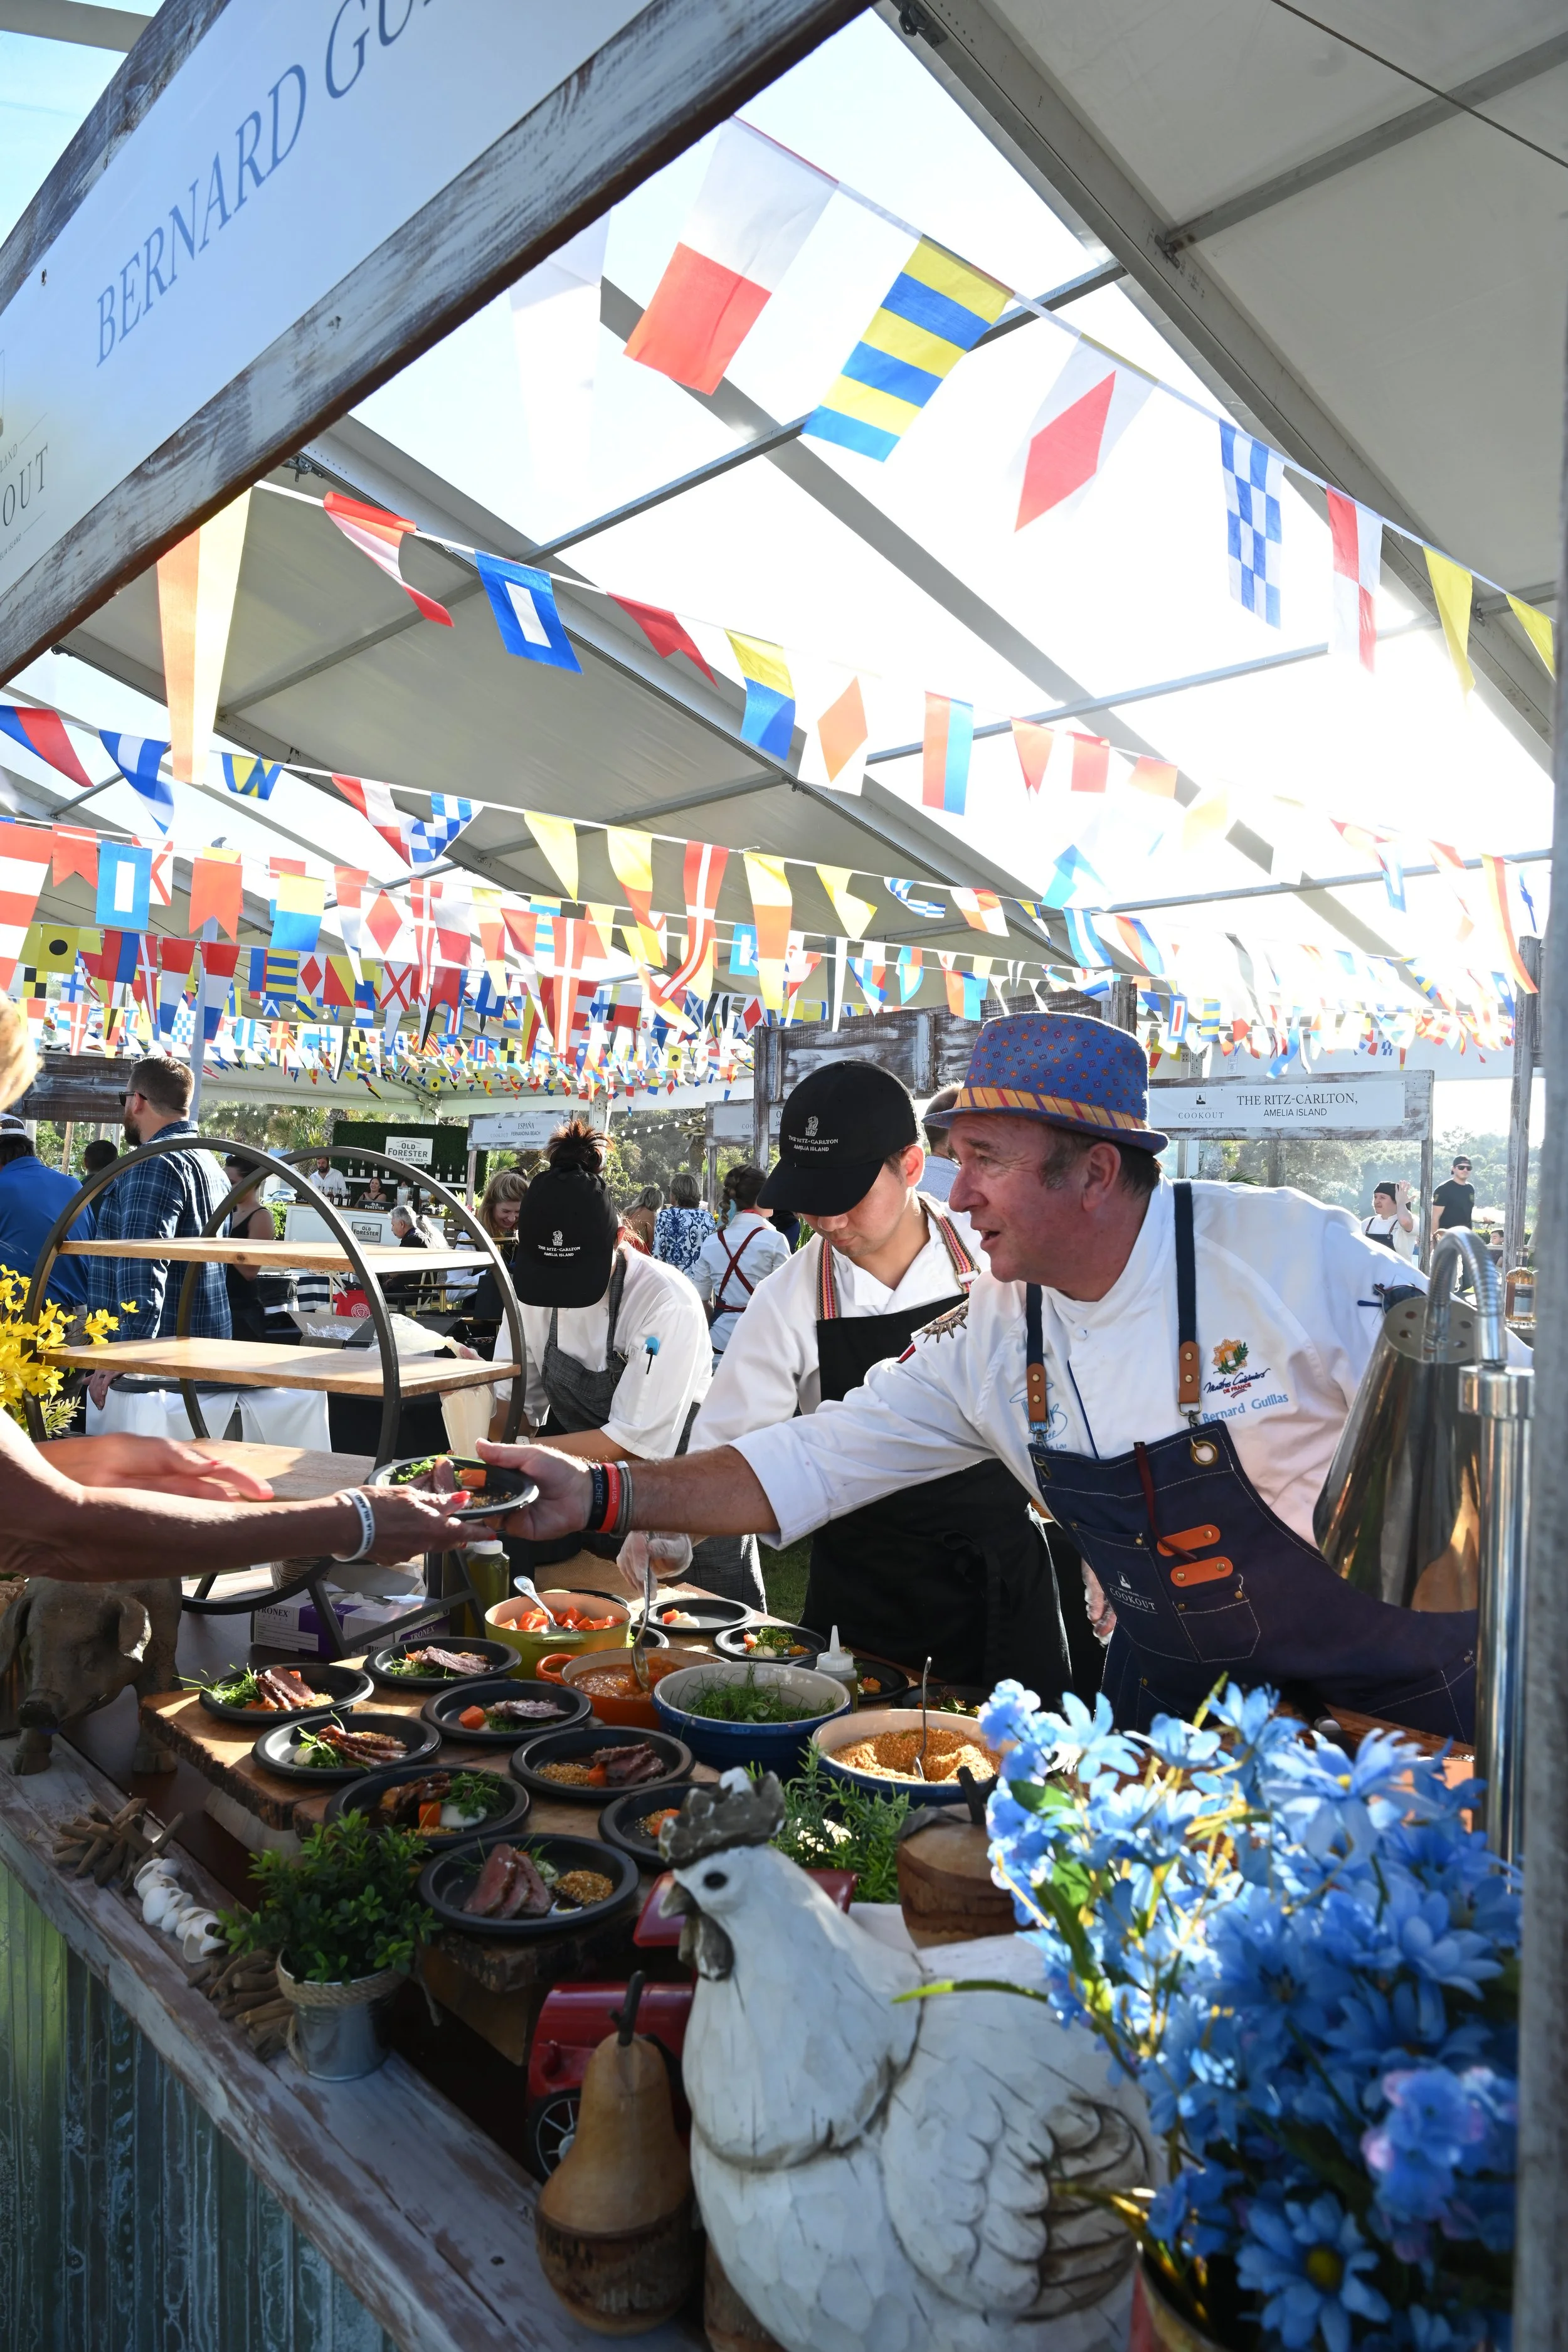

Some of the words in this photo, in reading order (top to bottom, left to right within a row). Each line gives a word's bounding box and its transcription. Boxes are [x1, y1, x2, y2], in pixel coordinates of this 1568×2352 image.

[97, 64, 307, 368] BERNARD
[1236, 1095, 1261, 1106] THE
[1264, 1093, 1358, 1106] RITZ-CARLTON,
[1263, 1108, 1294, 1116] AMELIA
[1296, 1108, 1327, 1116] ISLAND
[517, 1121, 534, 1130] ESPAÑA
[388, 1148, 428, 1158] FORESTER
[1231, 1382, 1252, 1392] FRANCE
[1202, 1402, 1246, 1424] Bernard
[1251, 1393, 1289, 1410] Guillas
[354, 1495, 371, 1522] ISLAND
[1110, 1587, 1155, 1610] COOKOUT
[410, 1625, 435, 1641] TRONEX
